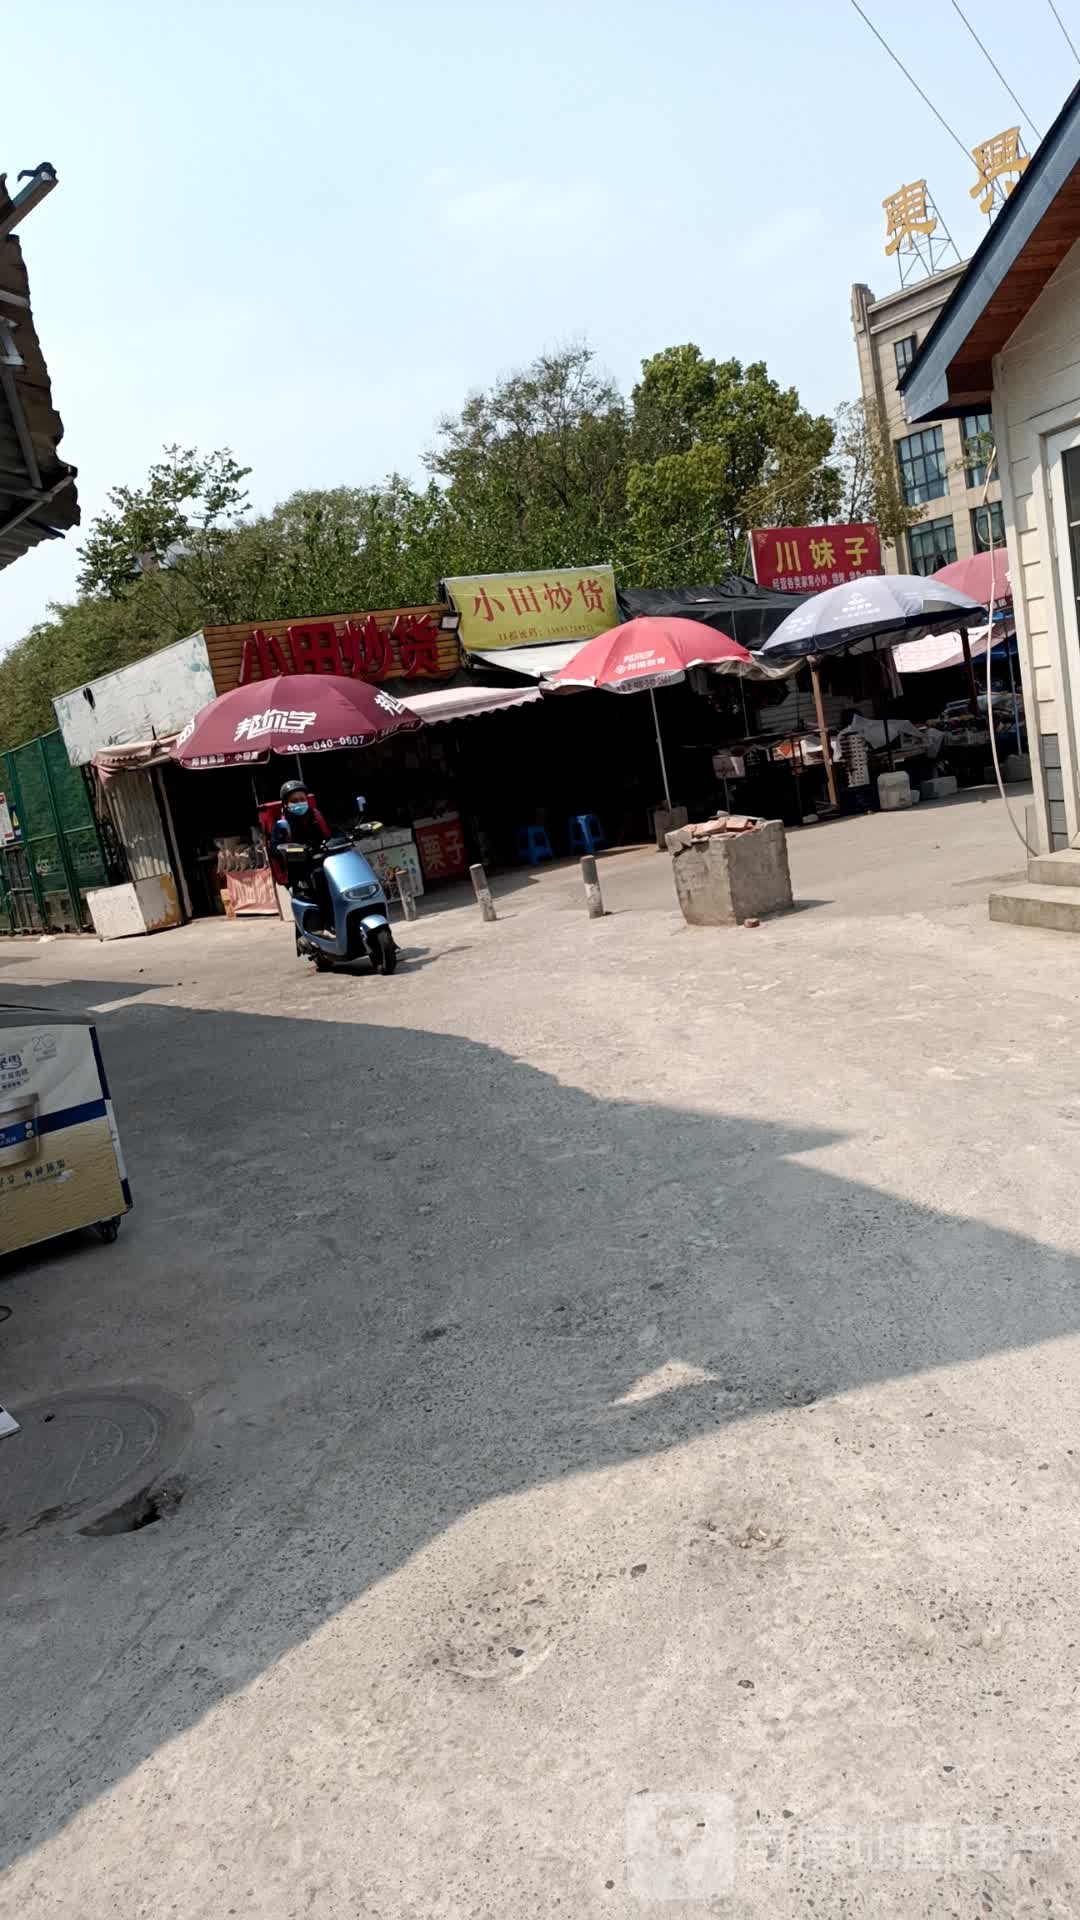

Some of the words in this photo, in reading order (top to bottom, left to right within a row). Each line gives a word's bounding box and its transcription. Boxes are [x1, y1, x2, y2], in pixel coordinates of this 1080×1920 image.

[776, 537, 869, 573] 川妹子
[474, 579, 606, 622] 小田炒货
[238, 614, 440, 684] 小田炒货
